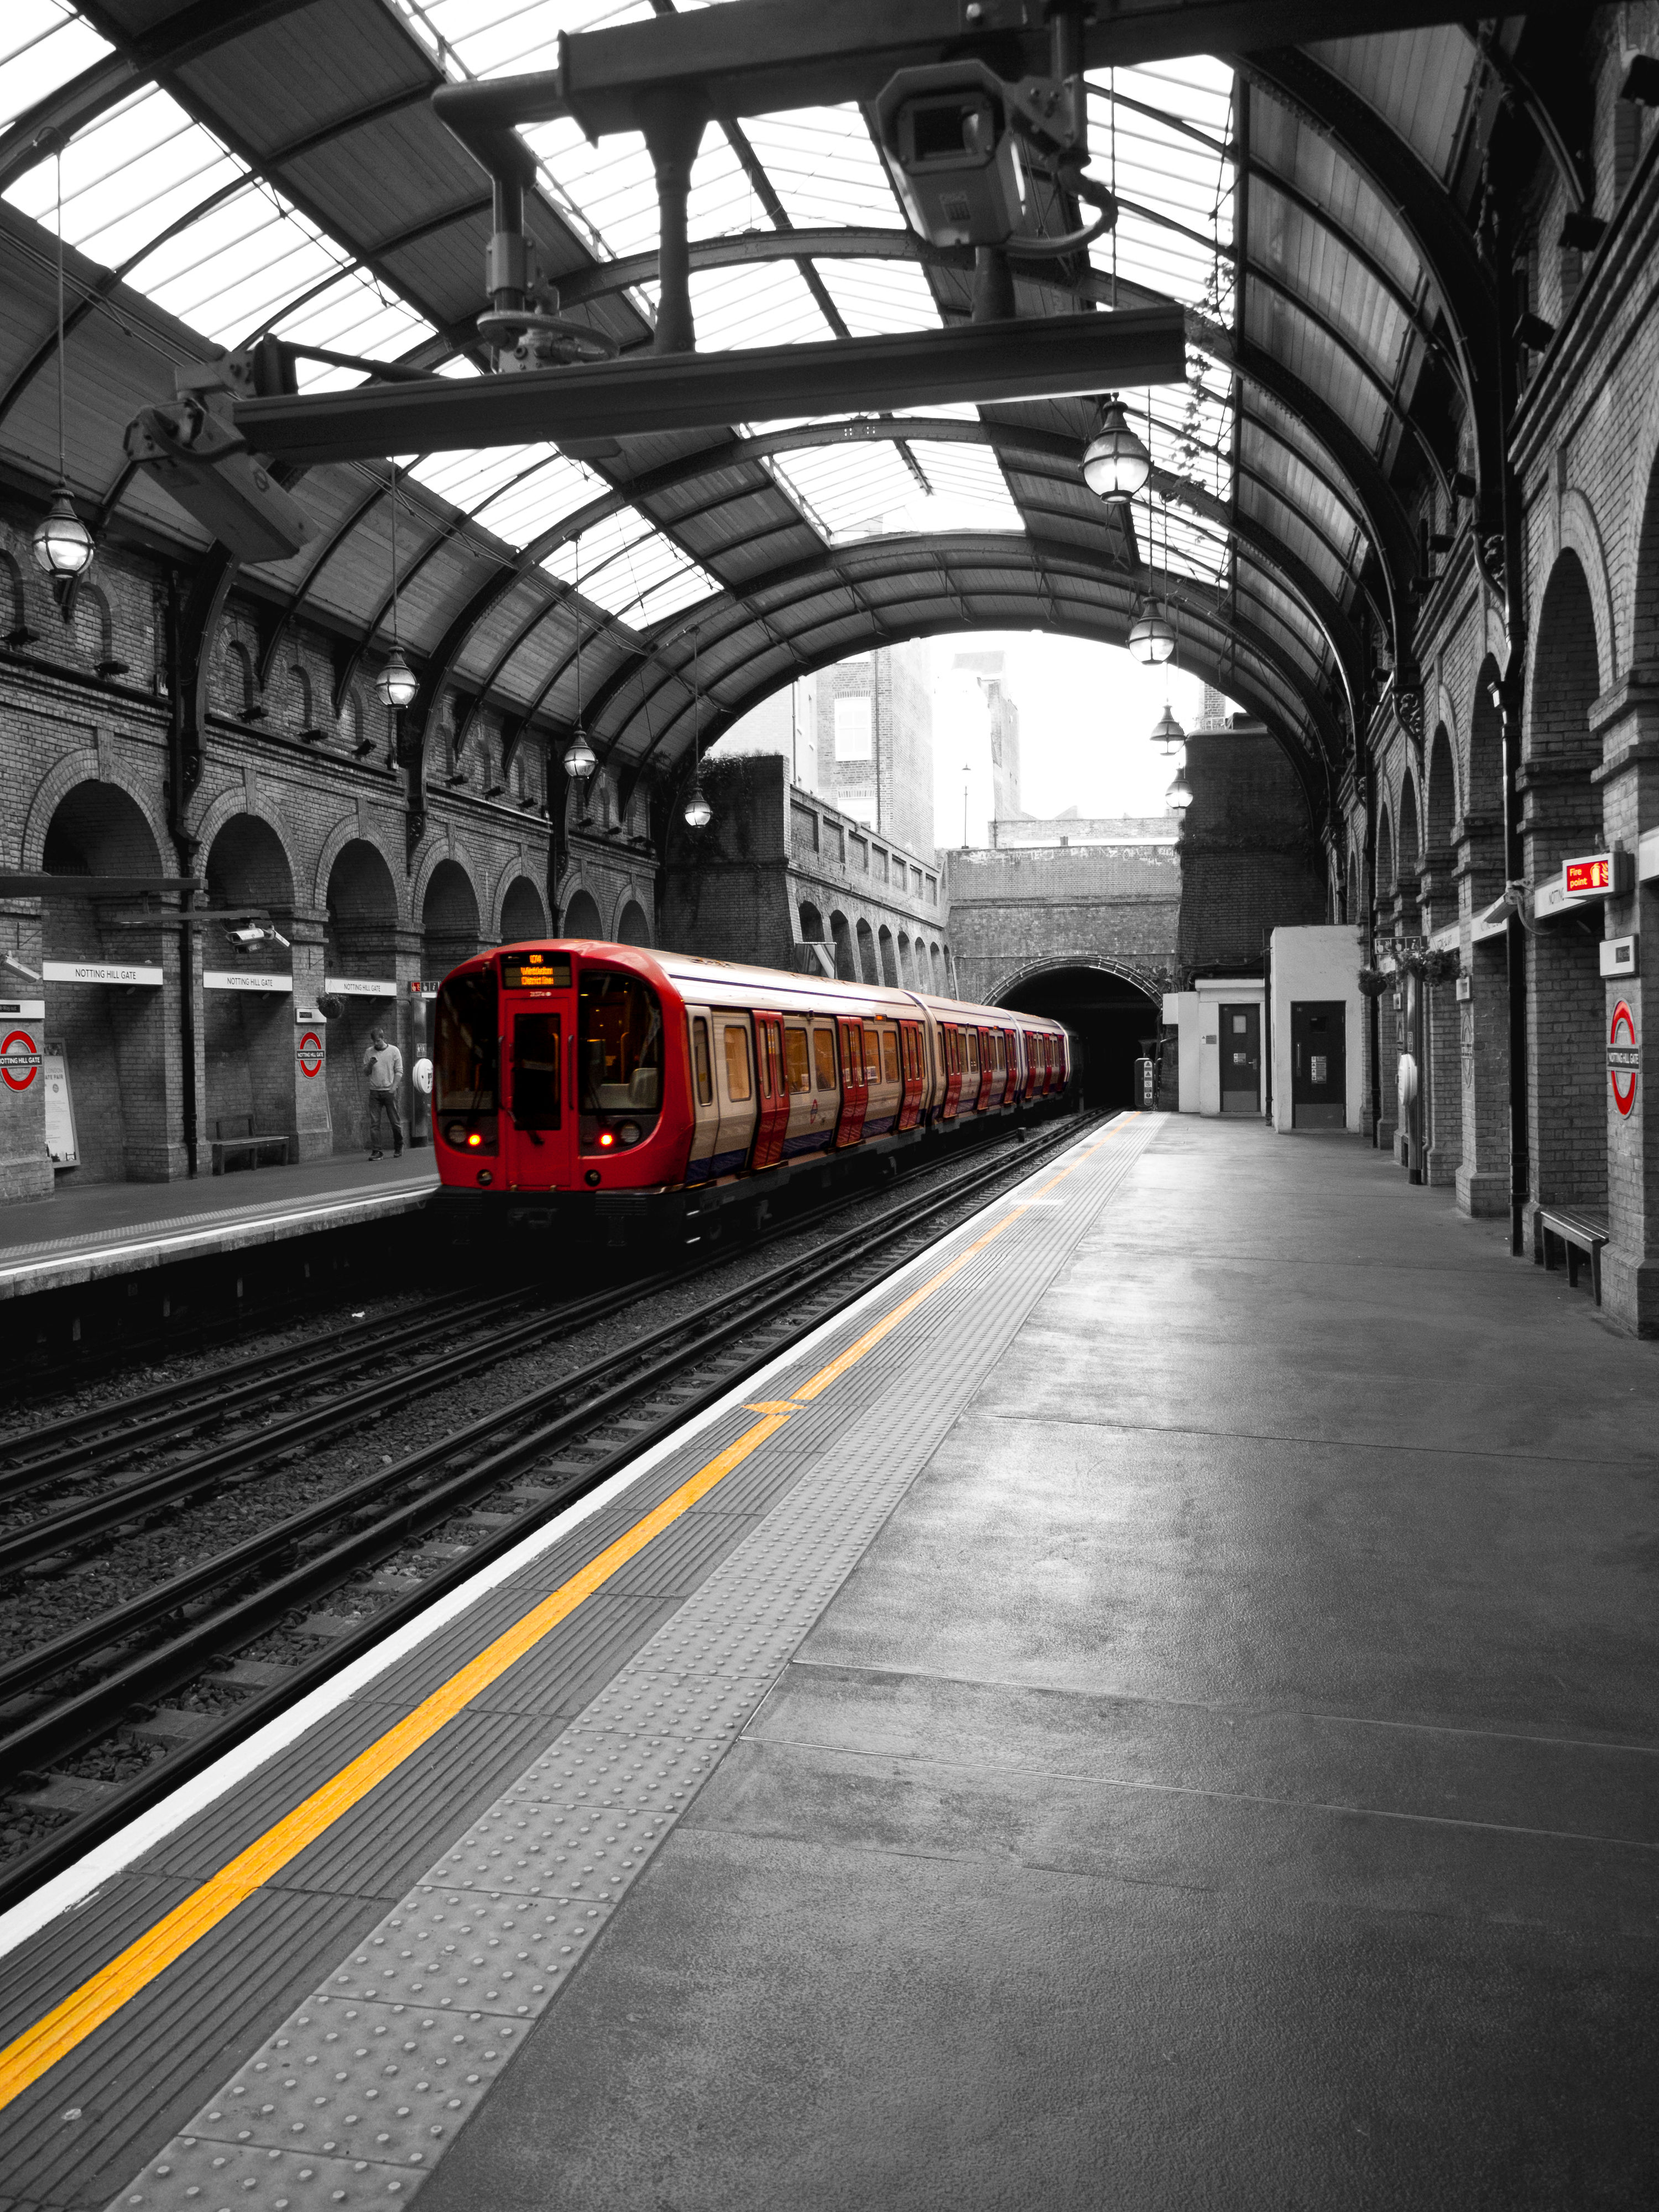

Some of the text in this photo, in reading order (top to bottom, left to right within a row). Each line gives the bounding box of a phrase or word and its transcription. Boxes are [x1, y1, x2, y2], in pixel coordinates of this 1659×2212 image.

[1569, 868, 1582, 877] Fire
[1569, 877, 1588, 889] point
[75, 969, 137, 979] NOTTING HILL GATE
[227, 977, 249, 985] NOTTING
[1609, 1052, 1623, 1063] NOTTING
[1630, 1053, 1639, 1065] GATE
